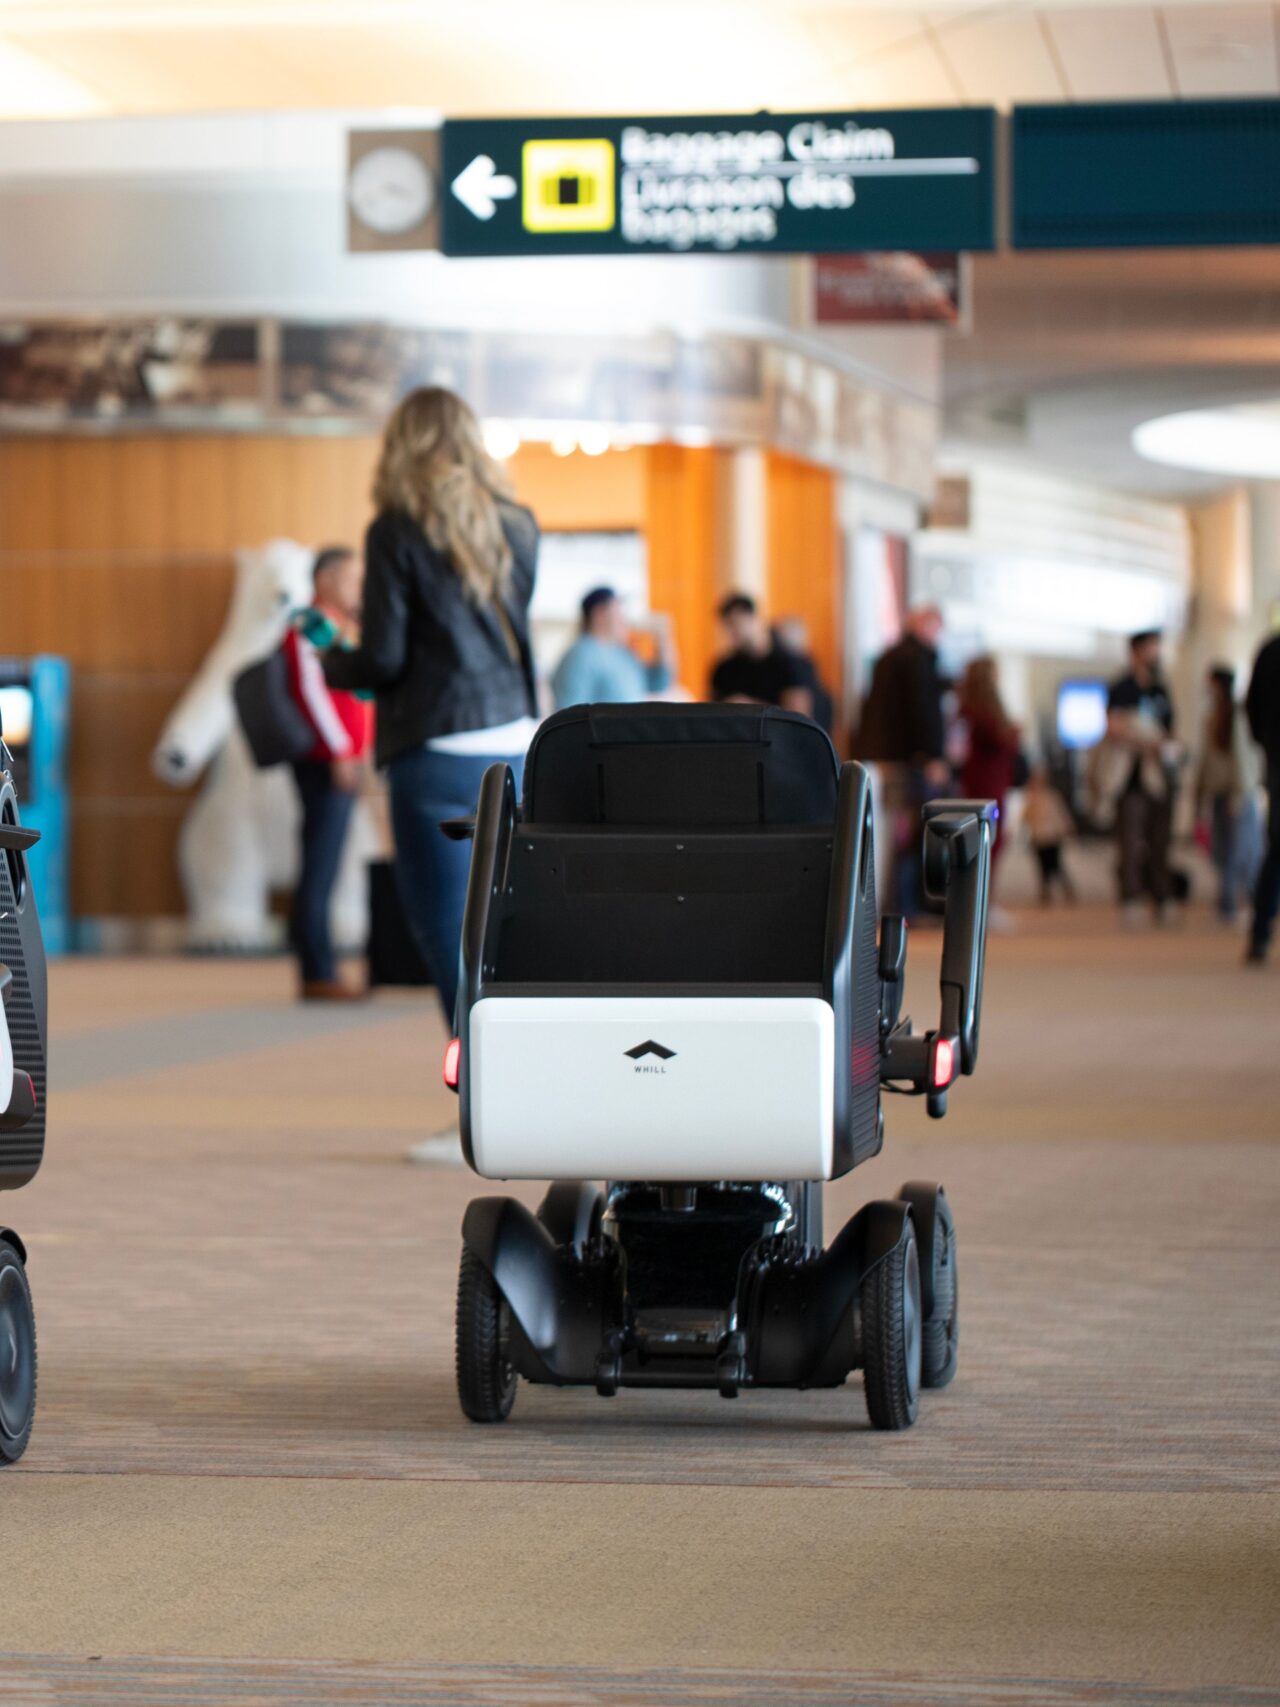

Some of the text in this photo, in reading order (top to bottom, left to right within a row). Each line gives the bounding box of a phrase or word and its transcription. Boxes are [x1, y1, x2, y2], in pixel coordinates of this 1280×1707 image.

[621, 121, 894, 174] Baggage Claim
[621, 166, 855, 210] Livraison des
[634, 1065, 667, 1073] WHILL
